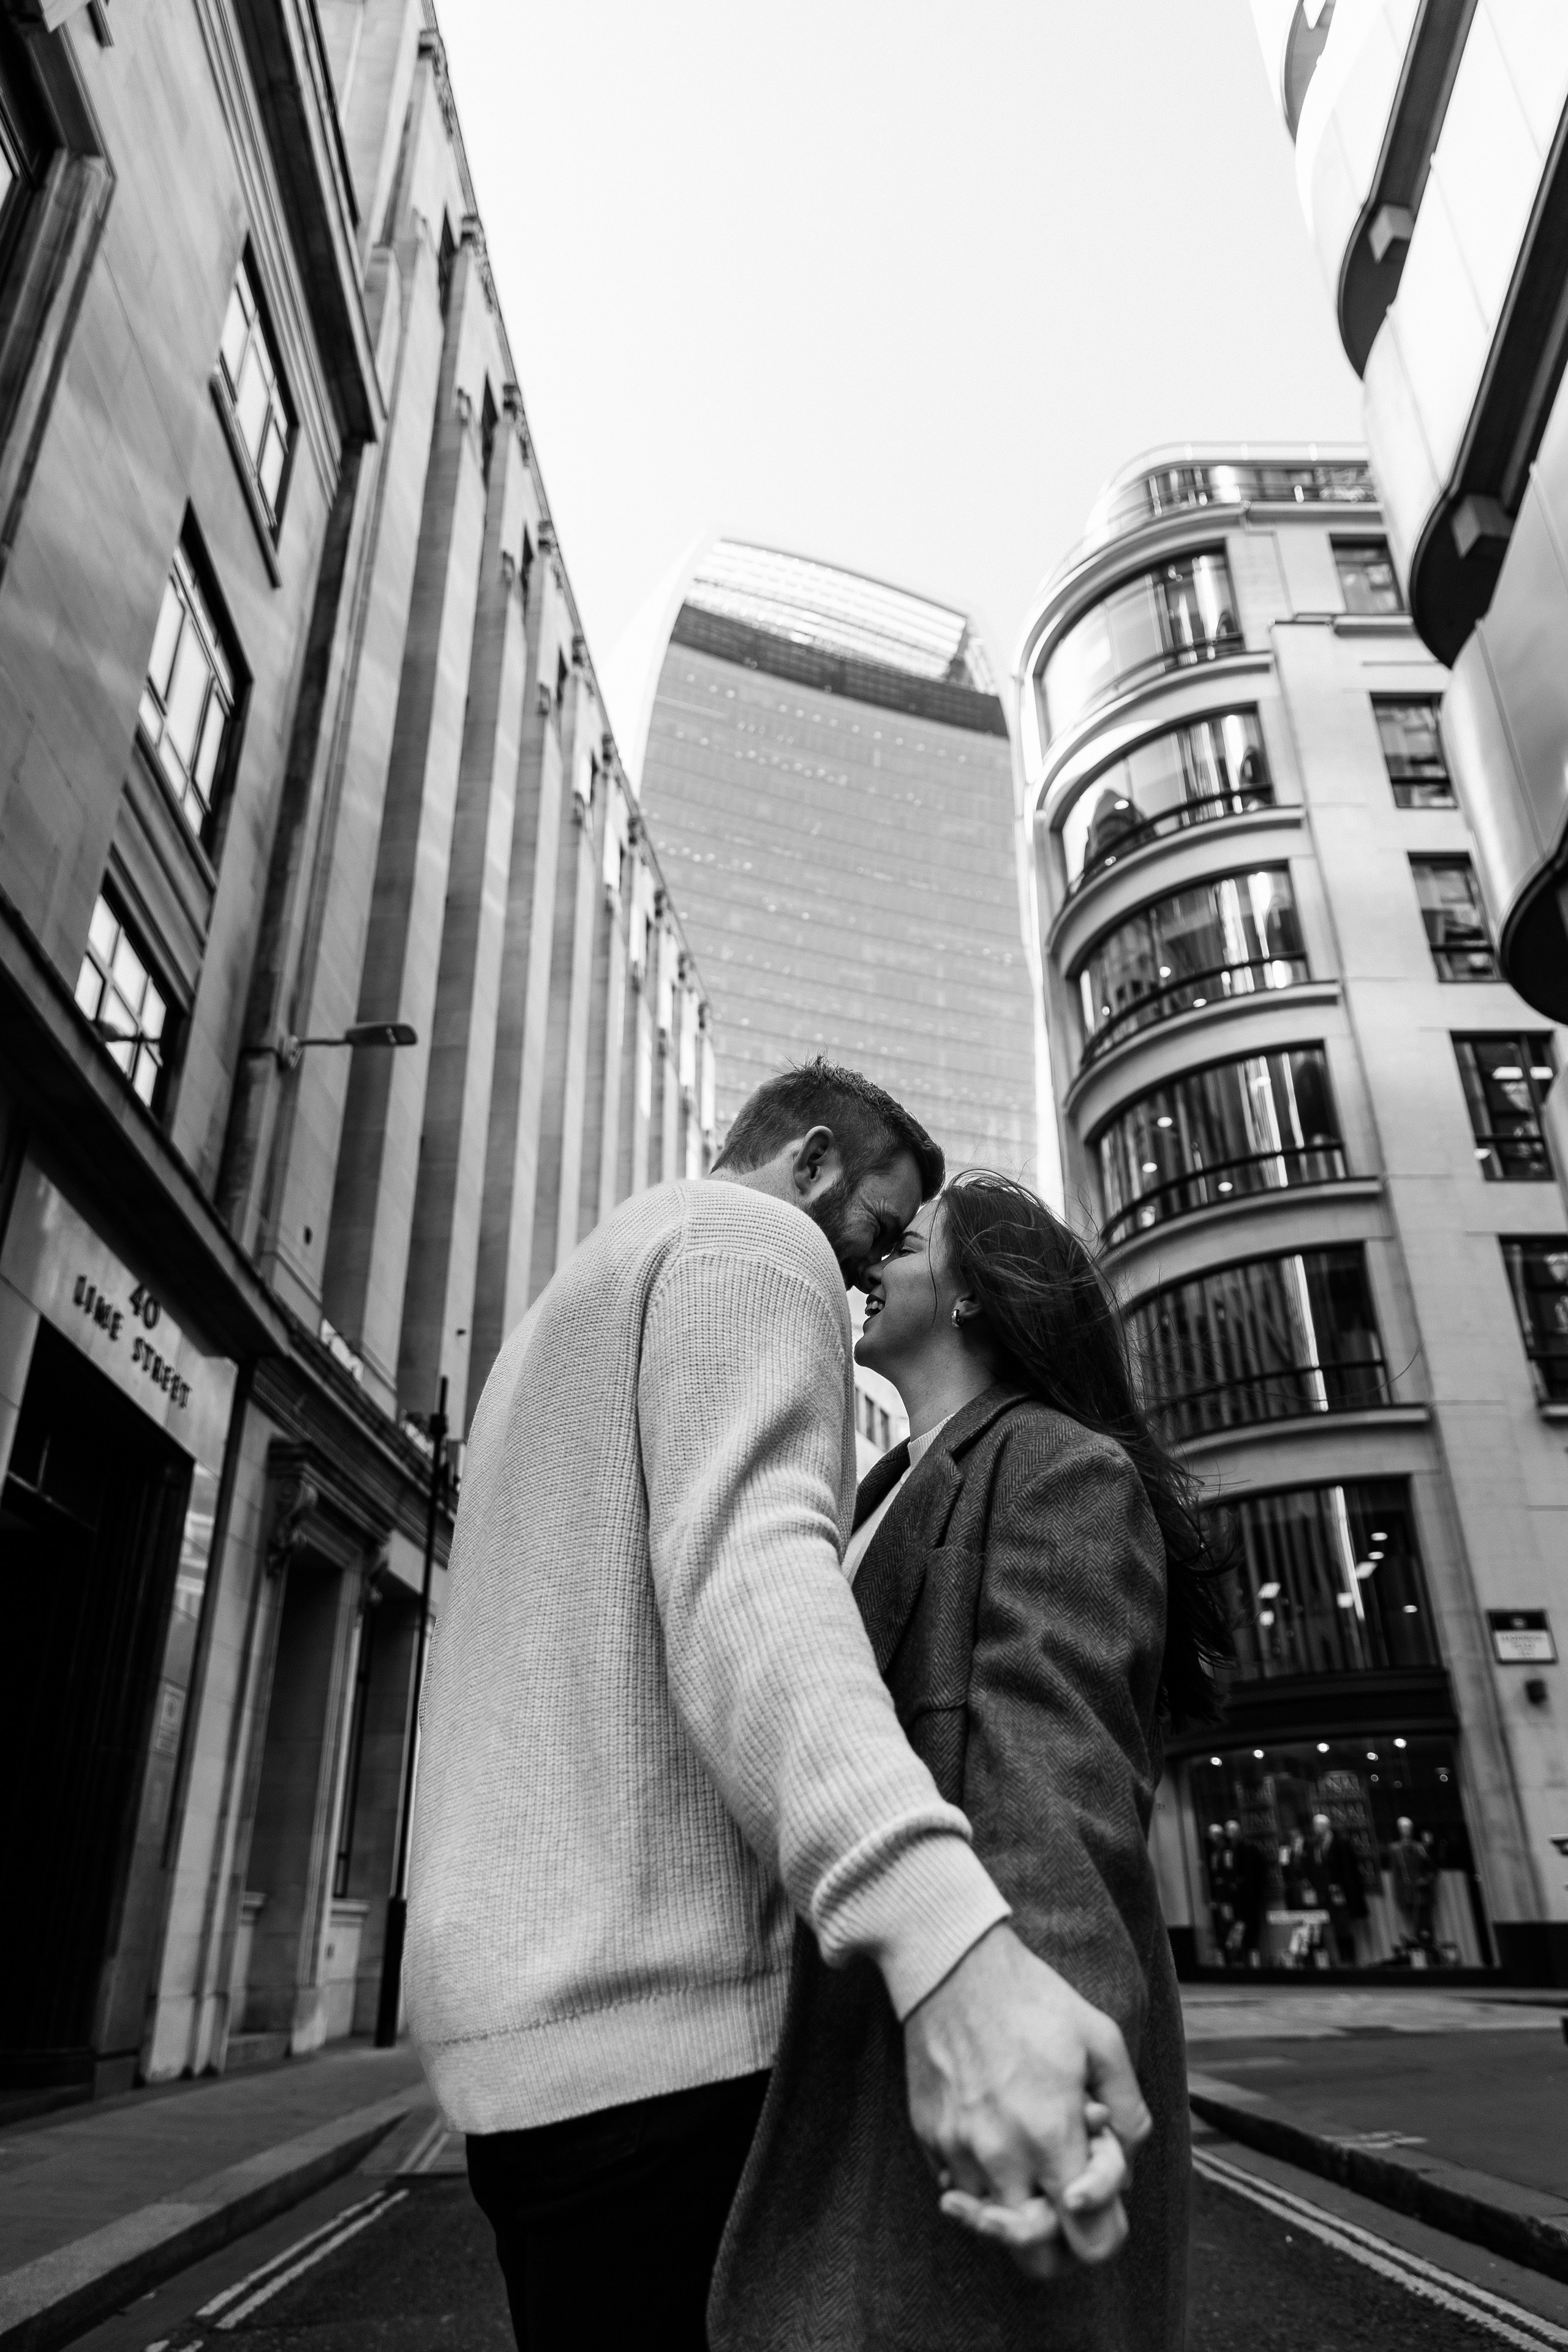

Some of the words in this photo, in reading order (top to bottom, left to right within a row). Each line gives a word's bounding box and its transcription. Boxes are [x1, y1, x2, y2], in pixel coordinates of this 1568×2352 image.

[73, 1275, 123, 1341] LIME
[132, 1337, 192, 1408] STREET
[129, 1285, 161, 1329] 40
